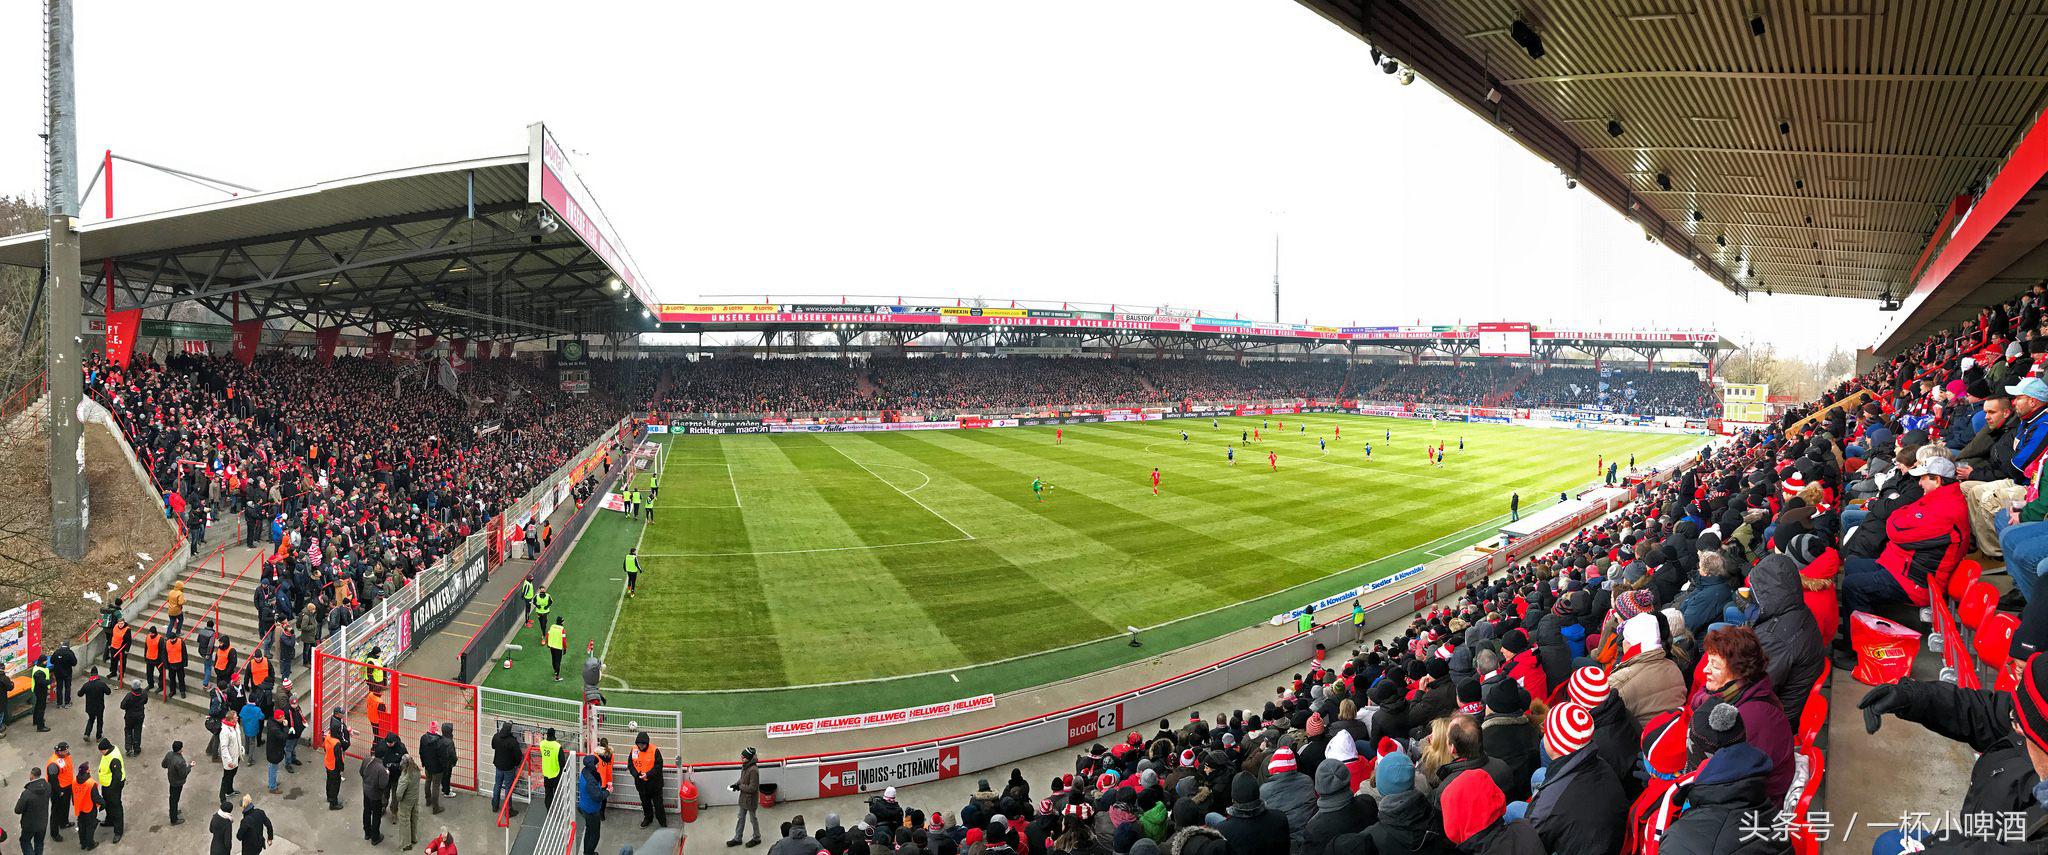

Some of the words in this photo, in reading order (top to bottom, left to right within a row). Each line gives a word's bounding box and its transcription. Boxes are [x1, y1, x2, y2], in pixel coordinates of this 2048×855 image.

[1371, 577, 1392, 590] Siedler
[1399, 564, 1424, 579] Kowalski
[1326, 590, 1357, 606] Kowalski
[414, 586, 451, 633] KRANKER
[953, 696, 993, 710] HELLWEG
[864, 712, 906, 724] HELLWEG
[909, 704, 950, 718] HELLWEG
[768, 722, 813, 733] HELLWEG
[817, 717, 861, 729] HELLWEG
[1070, 722, 1097, 737] BLOCK
[543, 749, 551, 757] 28
